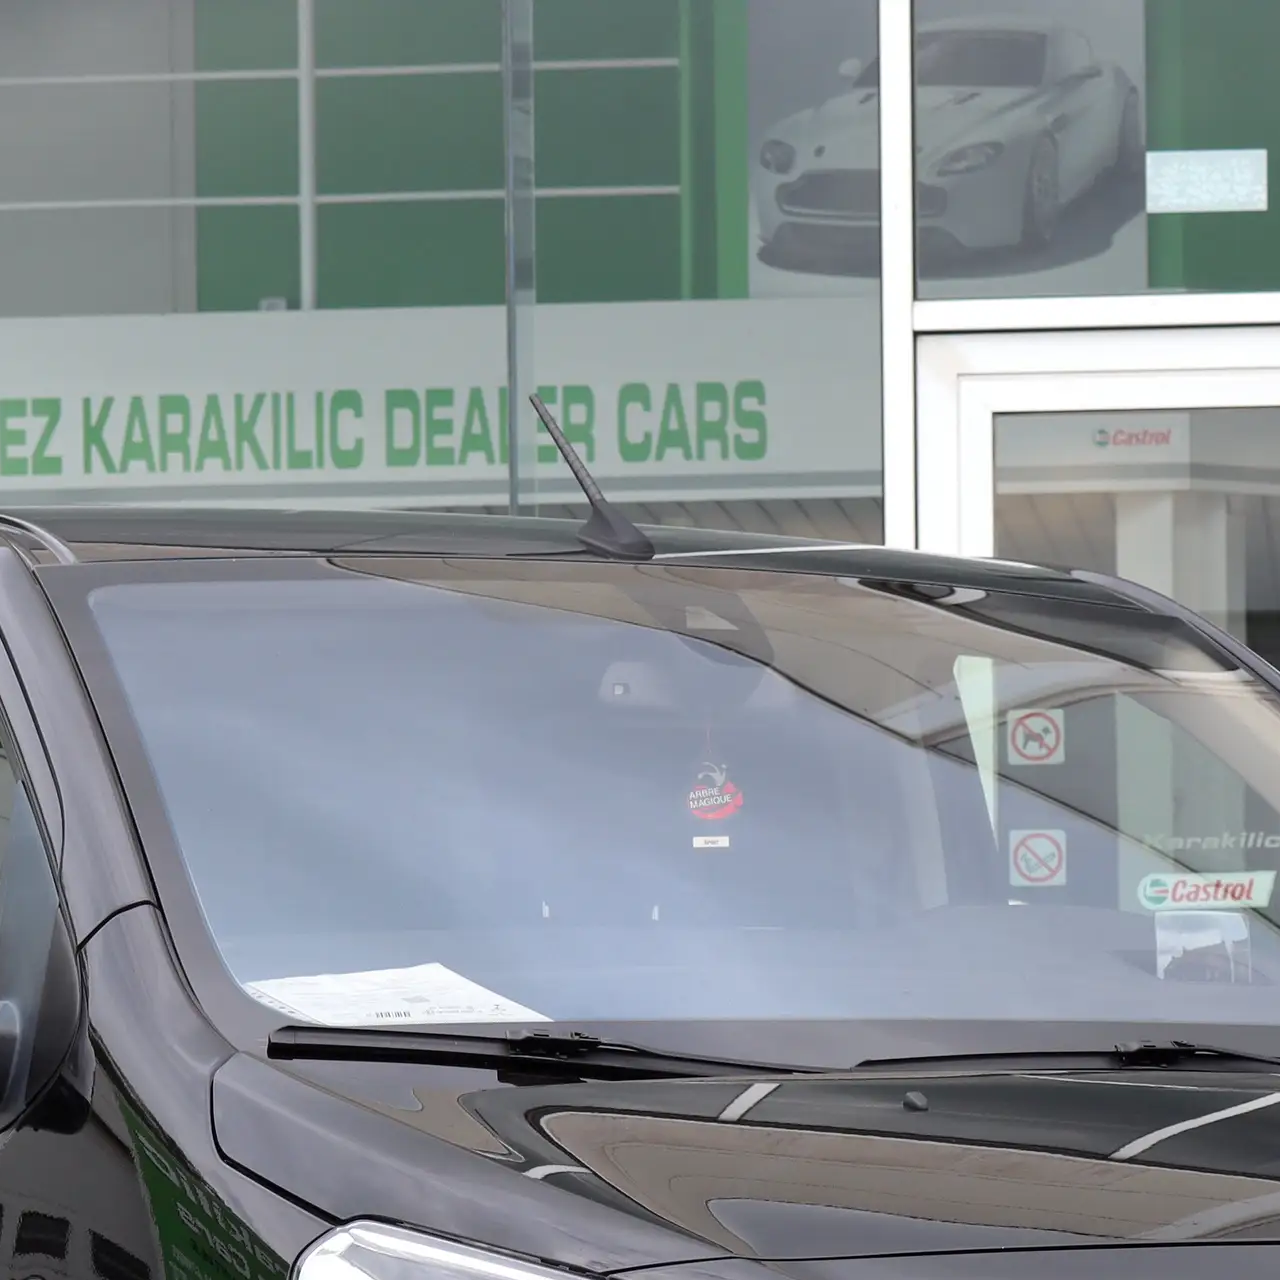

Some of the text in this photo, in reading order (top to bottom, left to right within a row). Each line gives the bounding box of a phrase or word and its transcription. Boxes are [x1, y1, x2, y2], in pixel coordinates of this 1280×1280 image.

[82, 389, 364, 473] KARAKILIC
[384, 385, 595, 467] DEALER
[618, 380, 768, 462] CARS
[689, 786, 720, 800] ARBRE
[689, 794, 732, 809] MAGIQUE
[1171, 878, 1255, 903] Castrol
